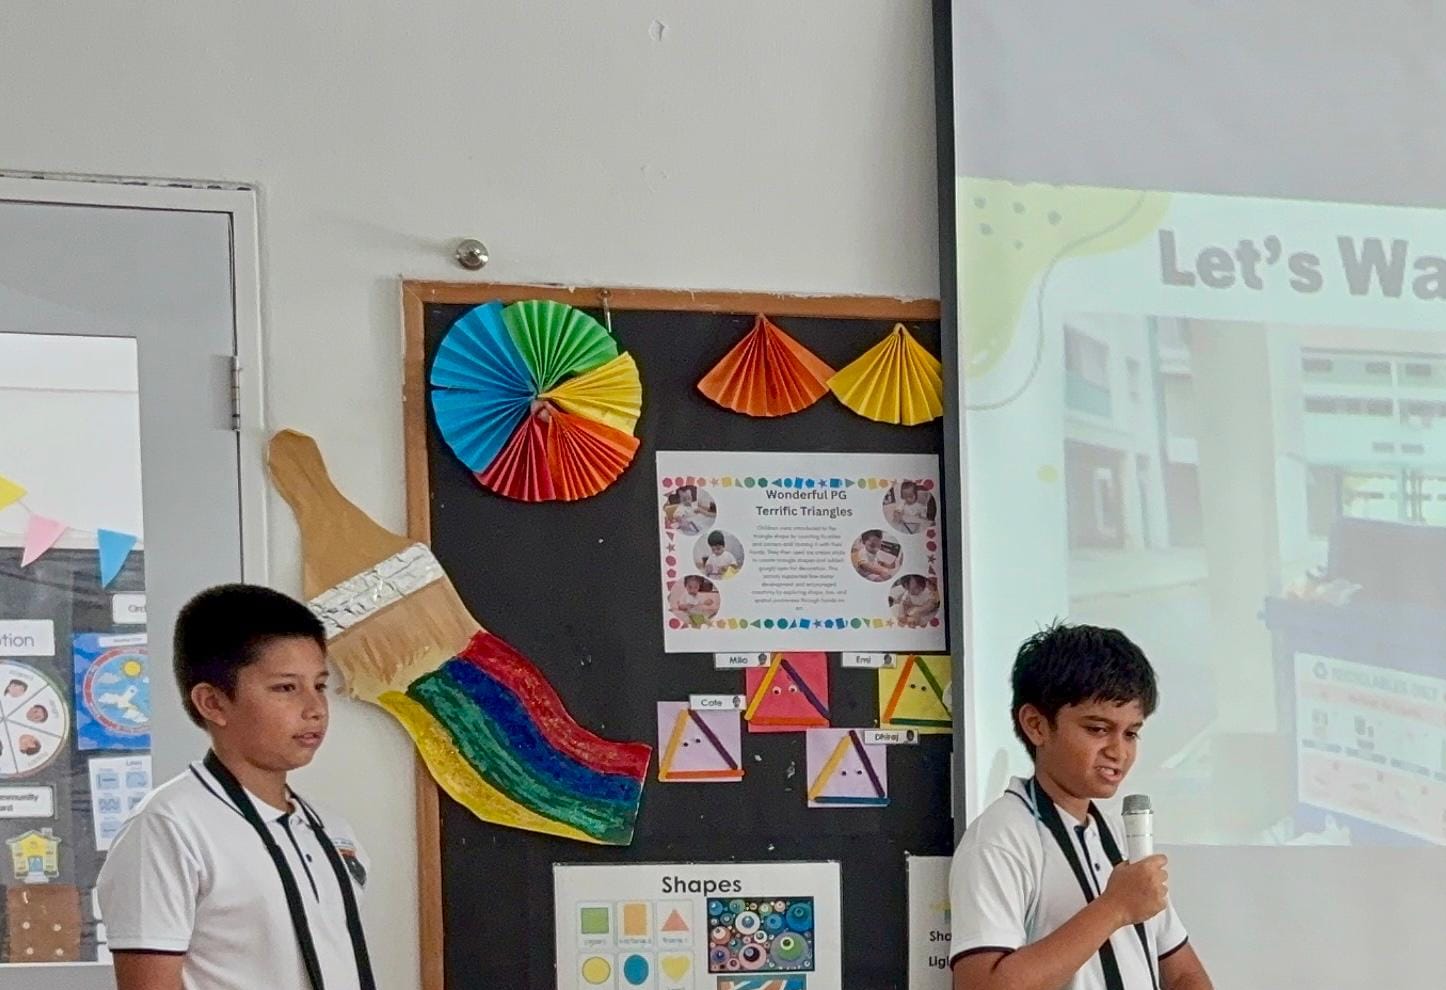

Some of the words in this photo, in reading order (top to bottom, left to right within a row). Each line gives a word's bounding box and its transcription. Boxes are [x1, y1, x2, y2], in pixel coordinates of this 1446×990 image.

[1159, 229, 1322, 292] Let's
[766, 489, 828, 500] Wonderful
[831, 491, 847, 500] PG
[756, 505, 798, 517] Terrific
[800, 506, 853, 519] Triangles
[0, 633, 35, 647] tion
[661, 876, 742, 896] Shapes
